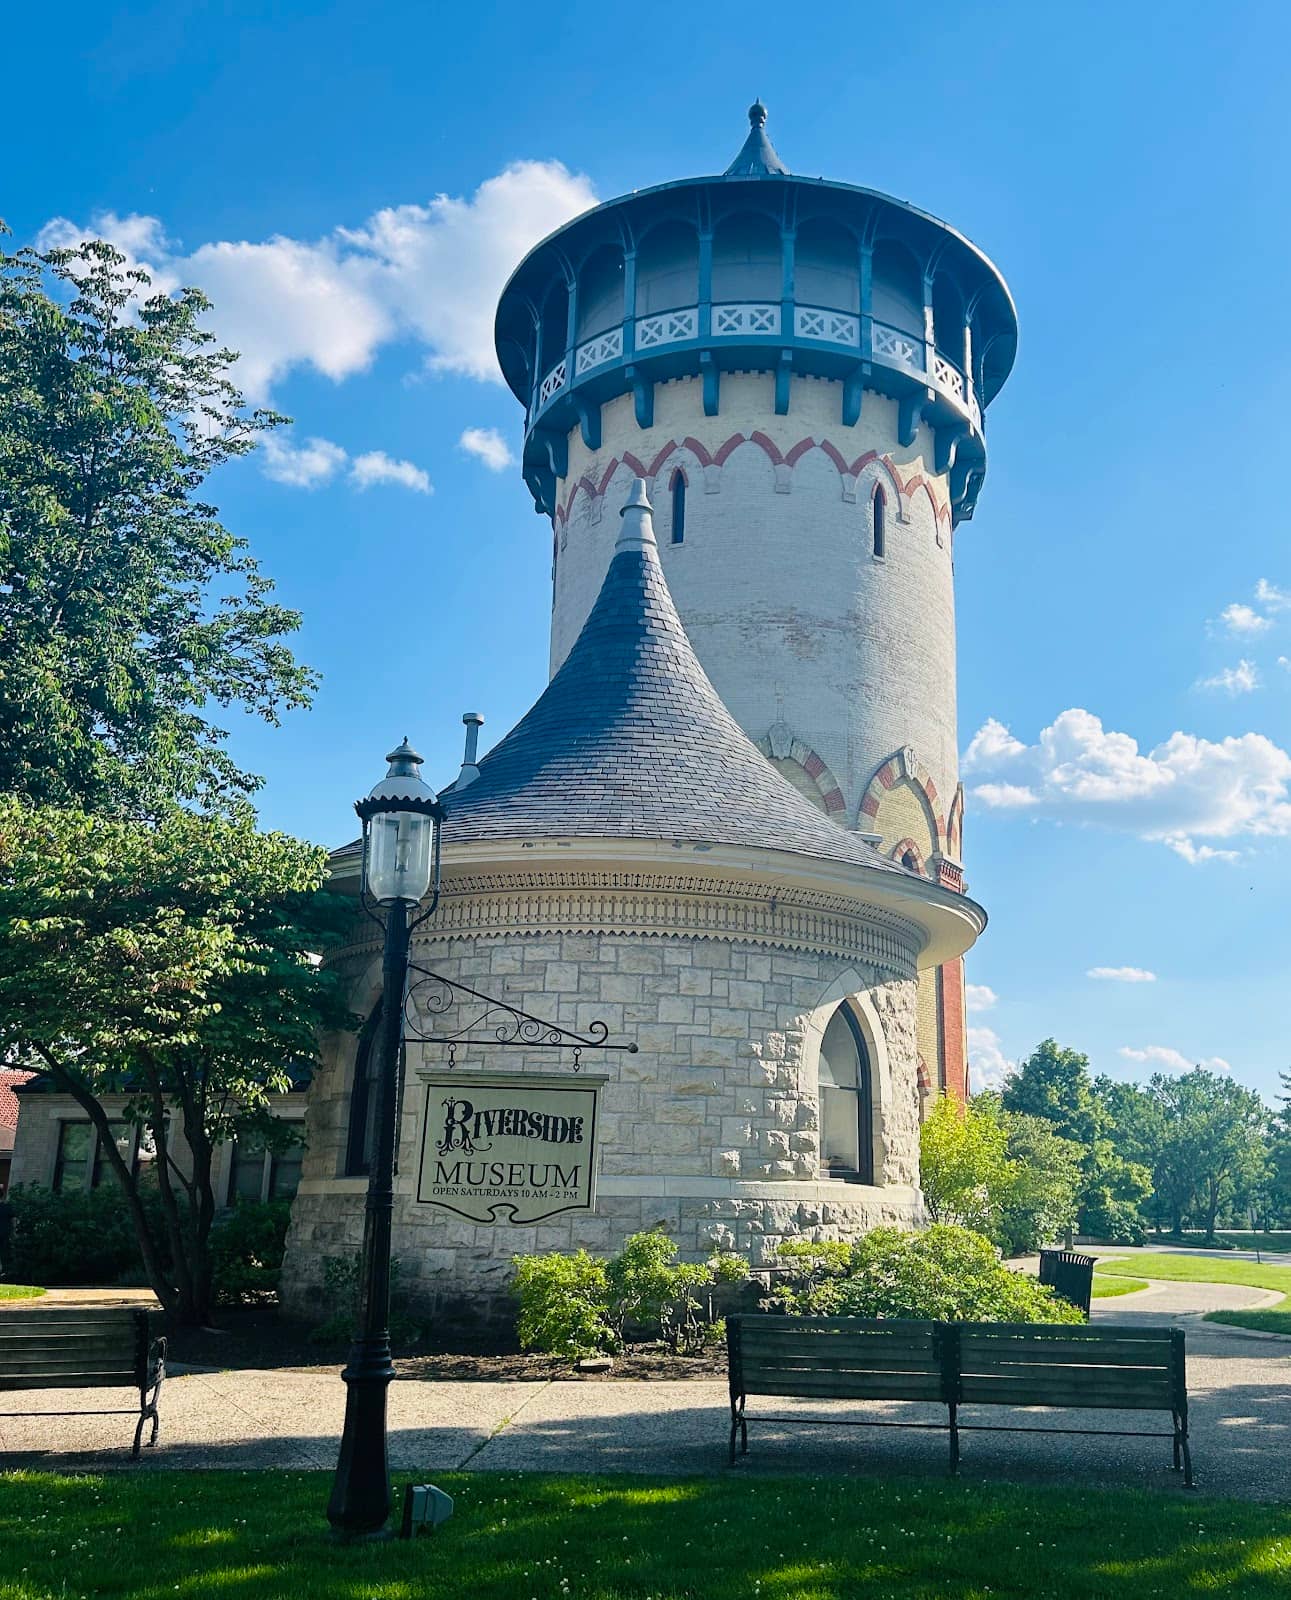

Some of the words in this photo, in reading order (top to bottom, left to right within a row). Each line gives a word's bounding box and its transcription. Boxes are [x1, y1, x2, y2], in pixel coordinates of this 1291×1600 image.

[433, 1161, 582, 1188] MUSEUM
[433, 1187, 459, 1195] OPEN
[461, 1189, 519, 1197] SATURDAYS
[522, 1190, 530, 1198] 10
[563, 1191, 577, 1199] PM
